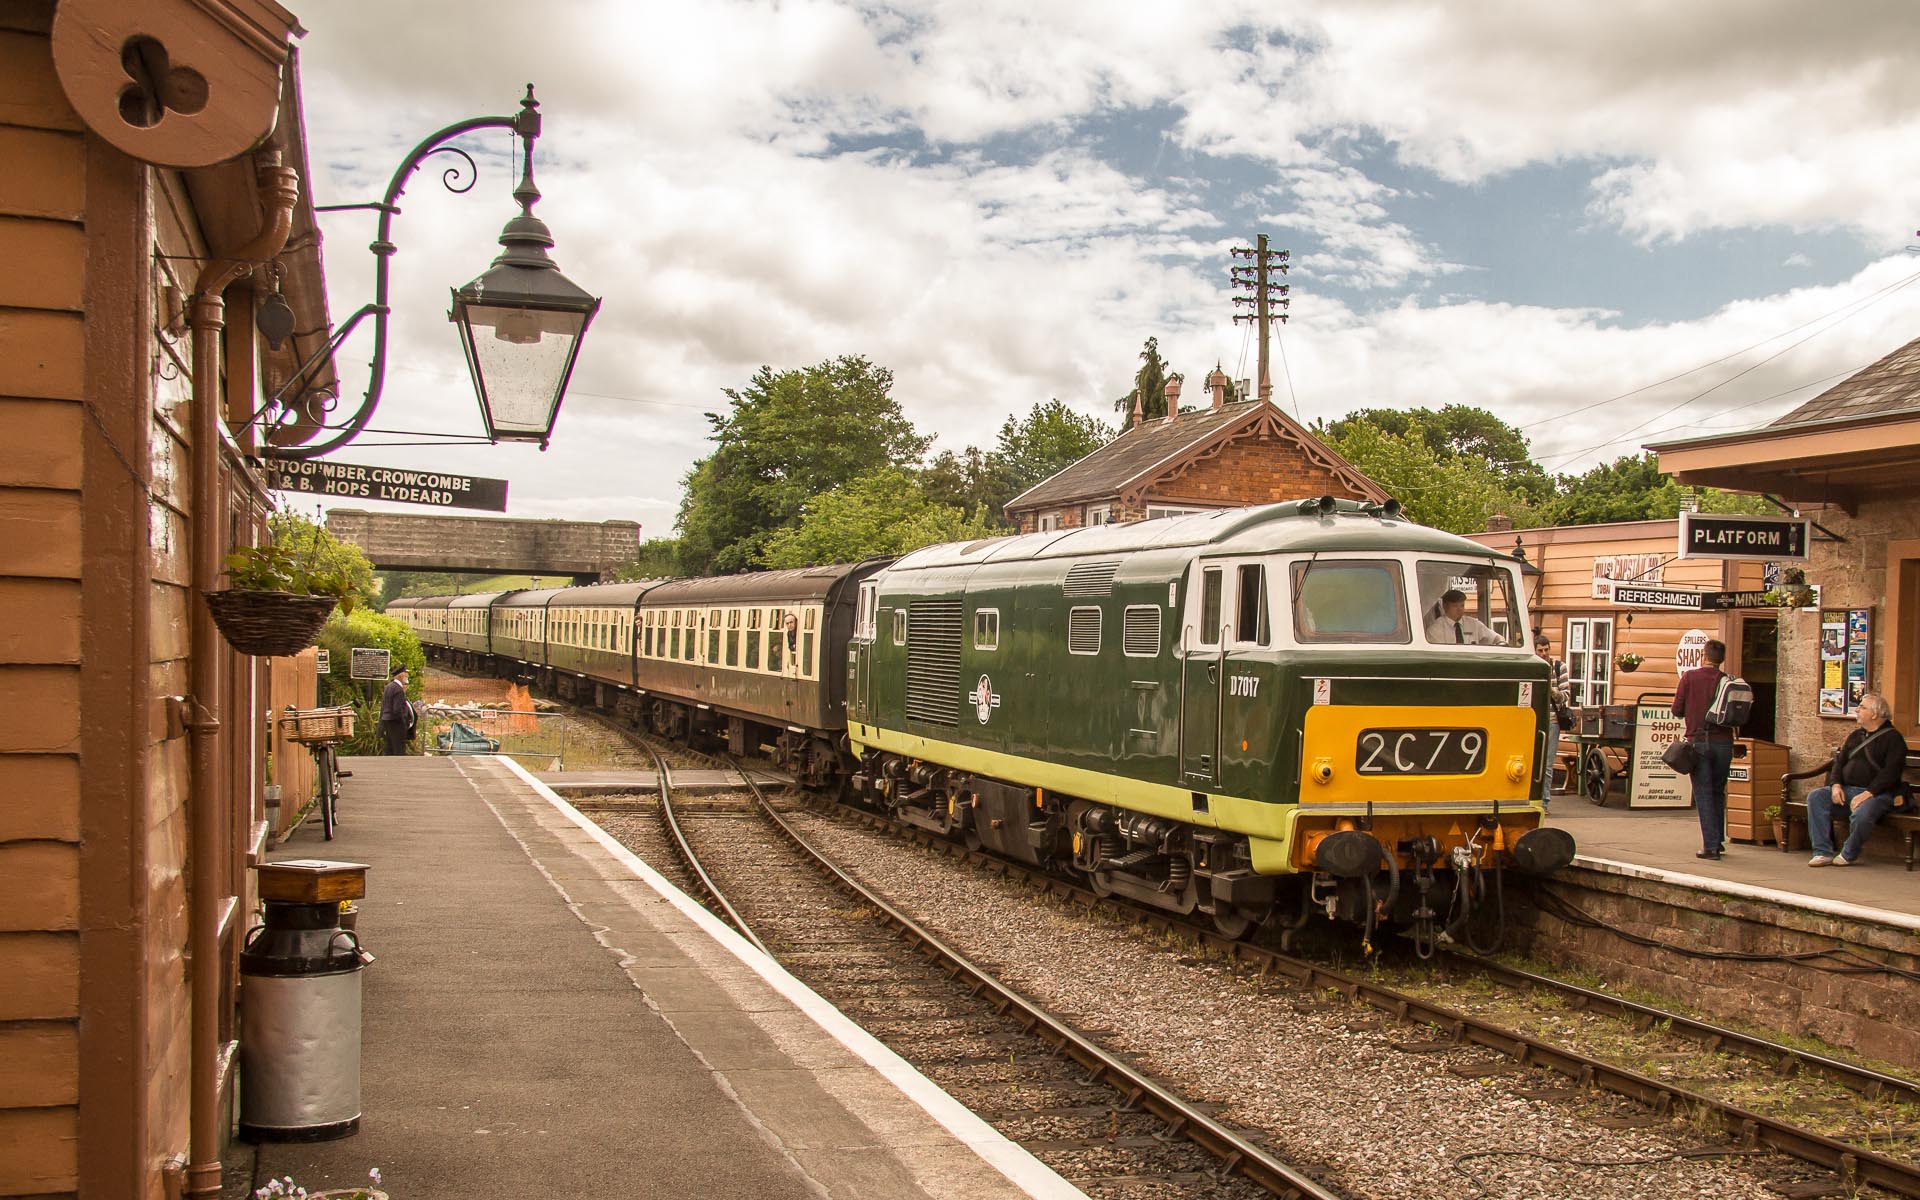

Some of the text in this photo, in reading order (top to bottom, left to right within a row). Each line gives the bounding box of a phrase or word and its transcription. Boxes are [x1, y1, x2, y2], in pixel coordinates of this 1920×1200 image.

[372, 469, 471, 492] CROWCOMBE
[282, 475, 453, 505] & BHOPS LYDEARD
[1695, 529, 1780, 545] PLATFORM
[1614, 558, 1646, 580] CAPSTAN
[1618, 590, 1701, 606] REFRESHMENT
[1735, 593, 1771, 607] MINE
[1684, 636, 1706, 645] SPILLERS
[1677, 648, 1704, 667] SHAP
[1230, 675, 1260, 697] D7017
[1641, 710, 1684, 719] WILLI
[1651, 722, 1681, 731] SHOP
[1651, 733, 1680, 742] OPEN
[1359, 732, 1482, 772] 2C79
[1730, 769, 1747, 777] LITTER
